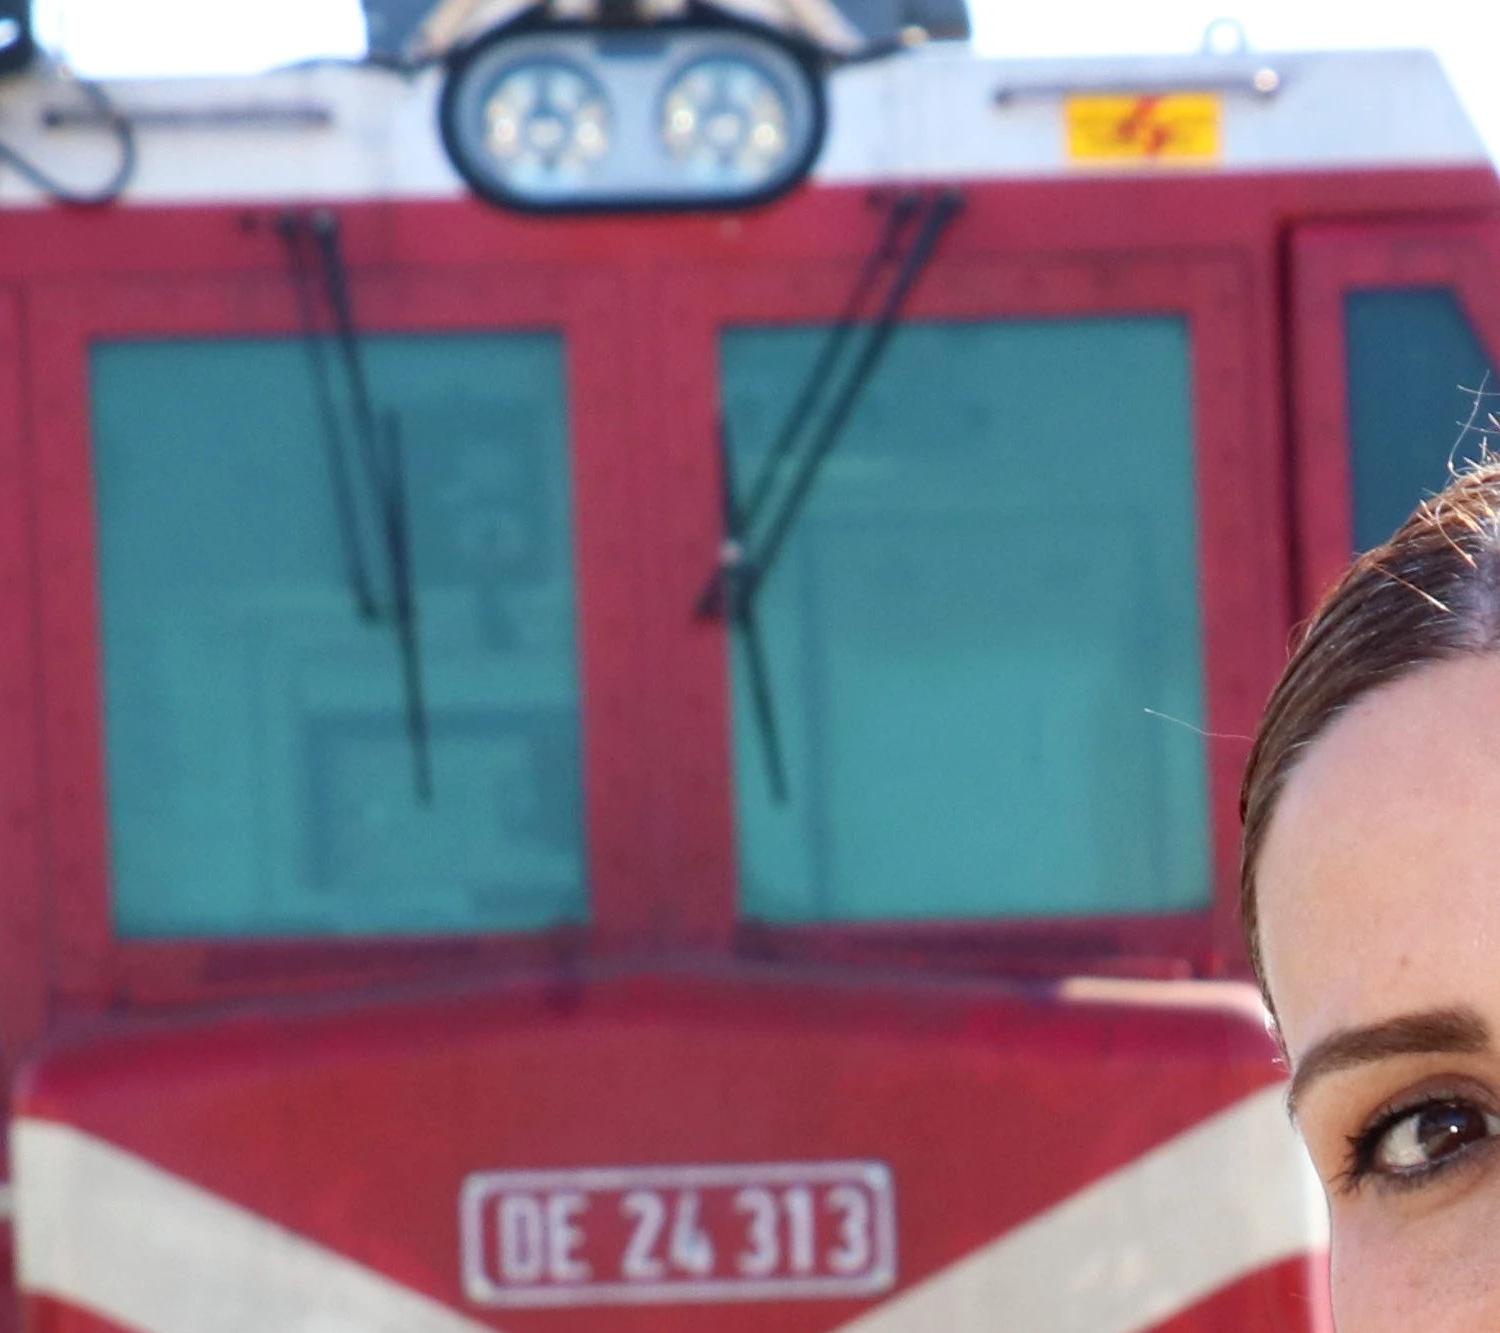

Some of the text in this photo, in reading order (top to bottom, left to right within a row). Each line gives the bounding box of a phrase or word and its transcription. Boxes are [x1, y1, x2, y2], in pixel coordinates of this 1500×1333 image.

[499, 1186, 871, 1283] DE 24 313
